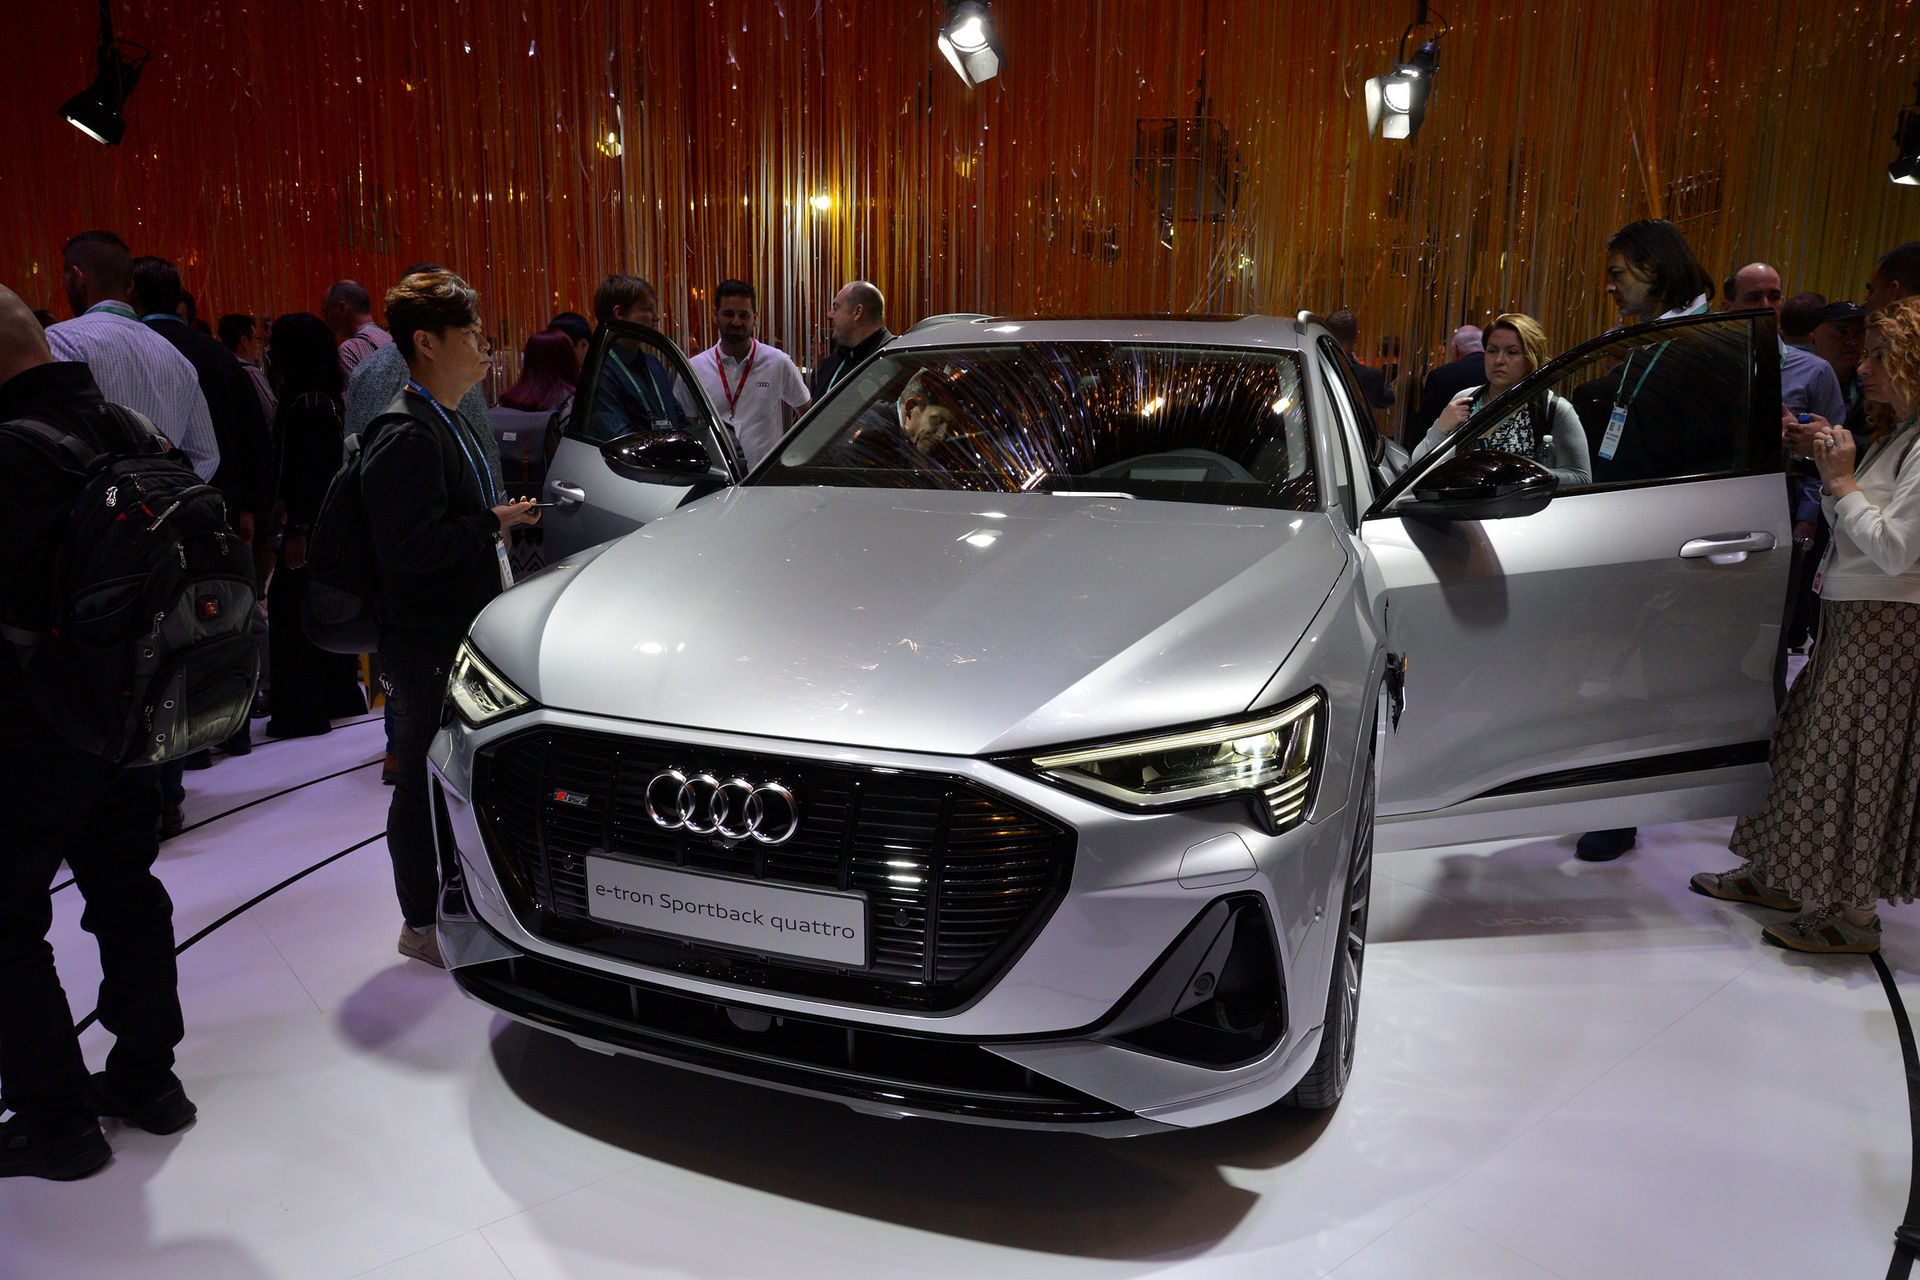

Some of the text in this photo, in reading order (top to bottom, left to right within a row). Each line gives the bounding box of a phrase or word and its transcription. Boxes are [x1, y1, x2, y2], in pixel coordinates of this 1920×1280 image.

[595, 883, 855, 939] e-tron Sportback quattro
